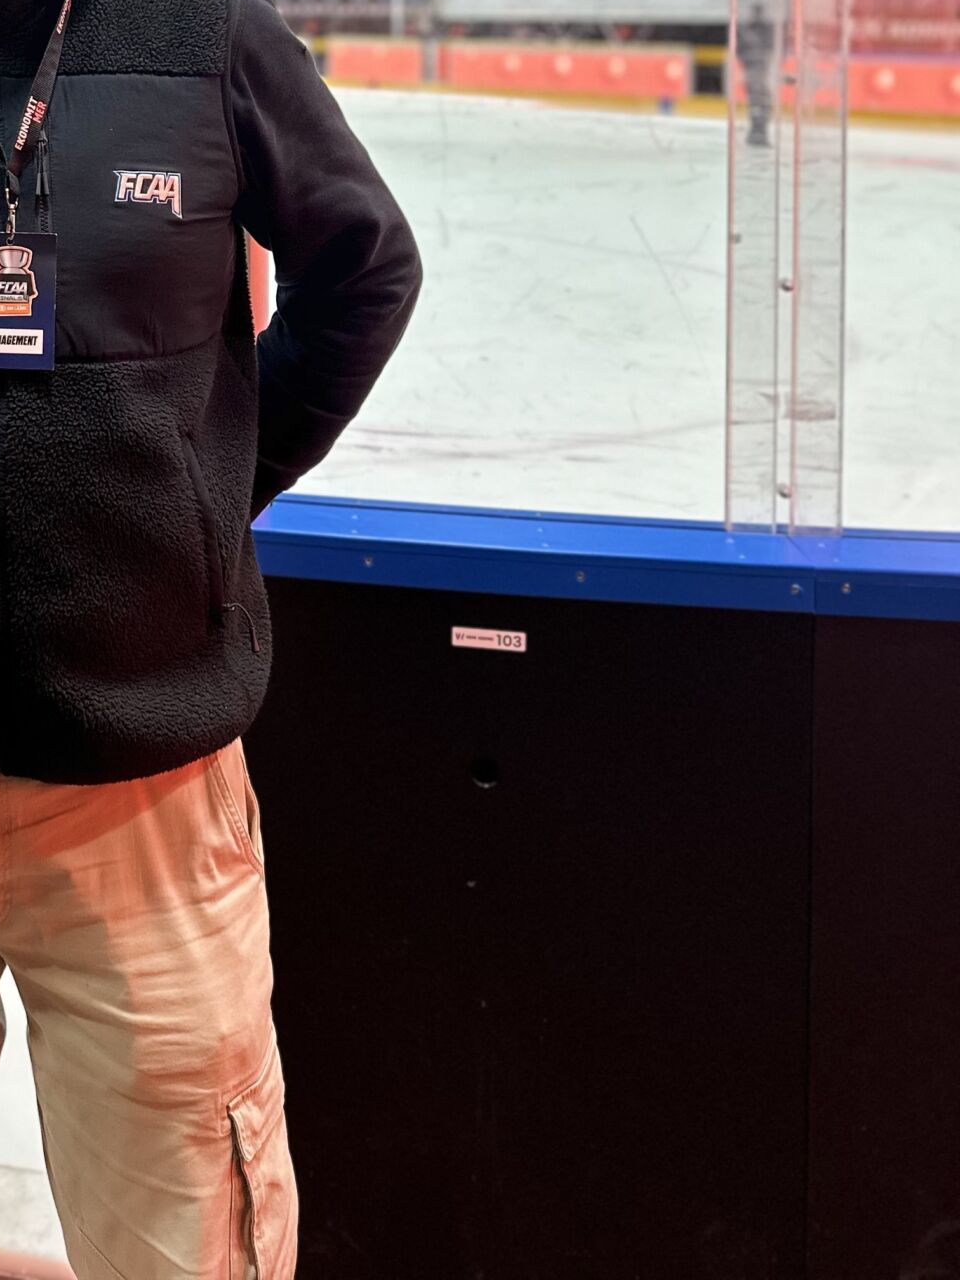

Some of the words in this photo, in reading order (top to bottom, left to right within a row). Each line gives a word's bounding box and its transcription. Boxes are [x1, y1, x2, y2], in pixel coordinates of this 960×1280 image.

[14, 95, 38, 151] EKONOMIT
[32, 101, 47, 124] MER
[113, 170, 182, 219] FCAA
[496, 634, 522, 648] 103
